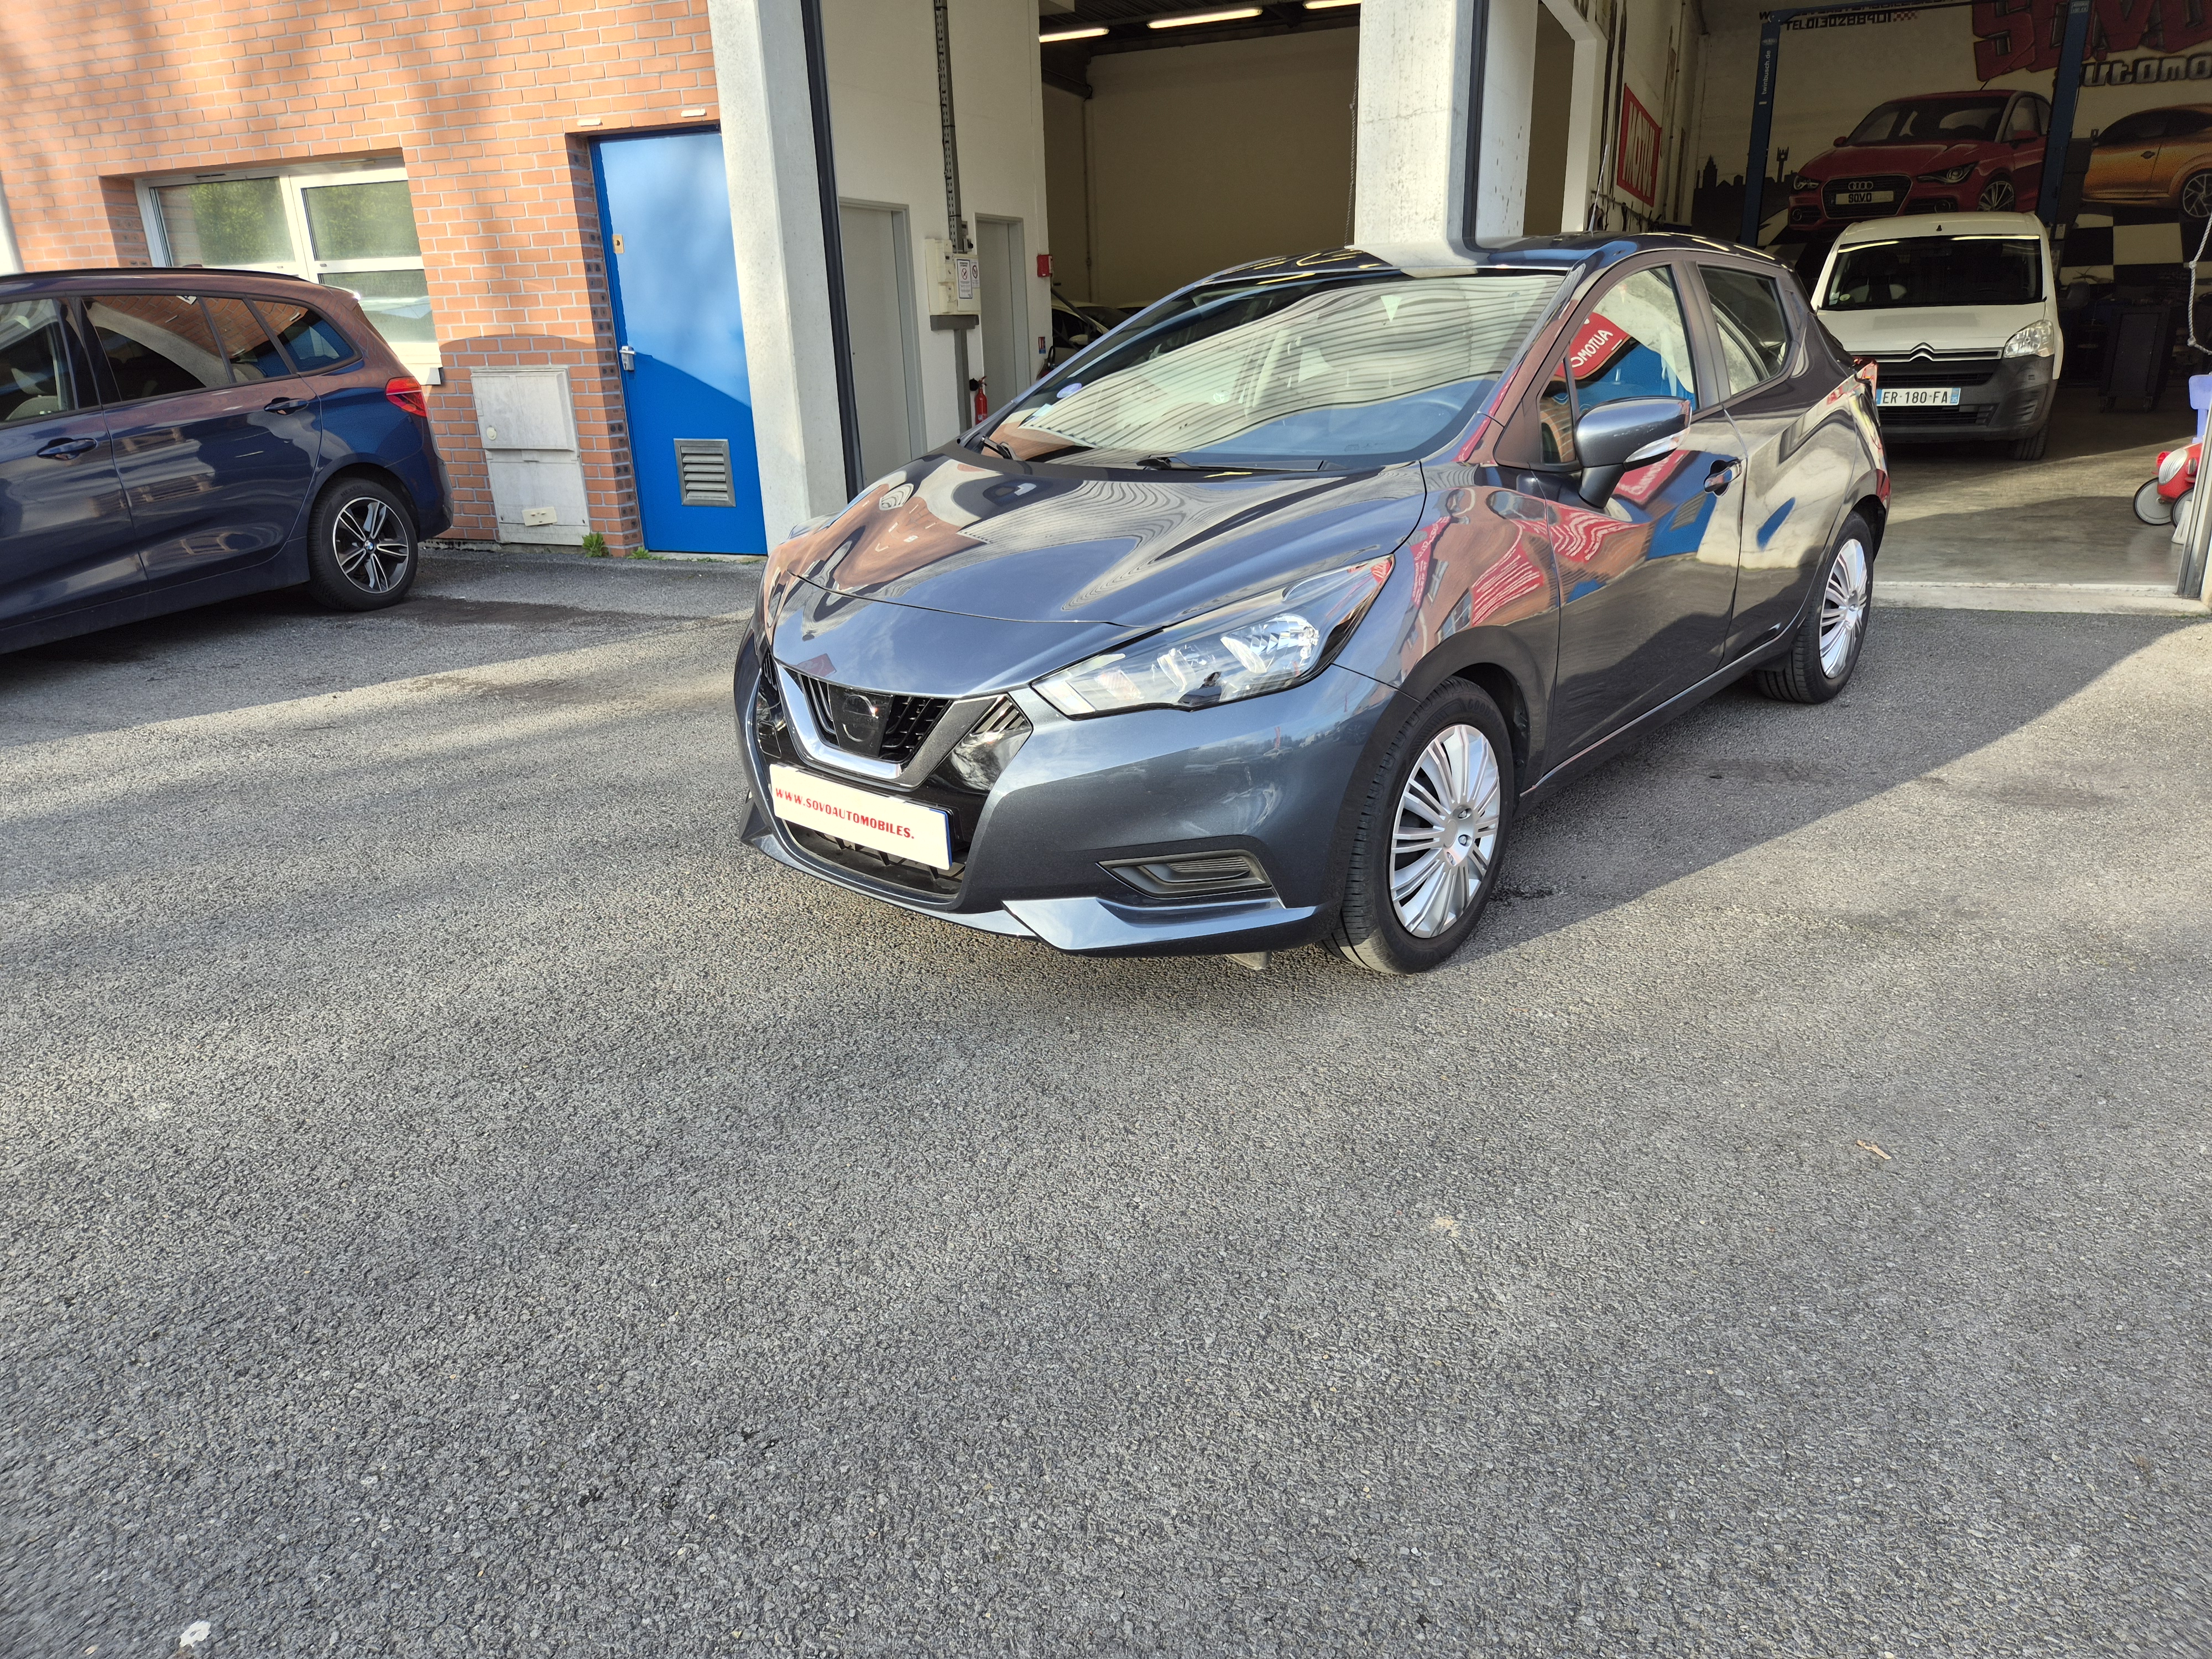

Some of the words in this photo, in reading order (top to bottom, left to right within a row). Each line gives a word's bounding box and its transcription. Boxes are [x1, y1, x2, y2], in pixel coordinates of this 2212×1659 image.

[1761, 50, 1771, 95] twinbusch.de
[1622, 100, 1655, 198] MOTUL
[775, 787, 915, 839] WWW.SOVOAUTOMOBILES.
